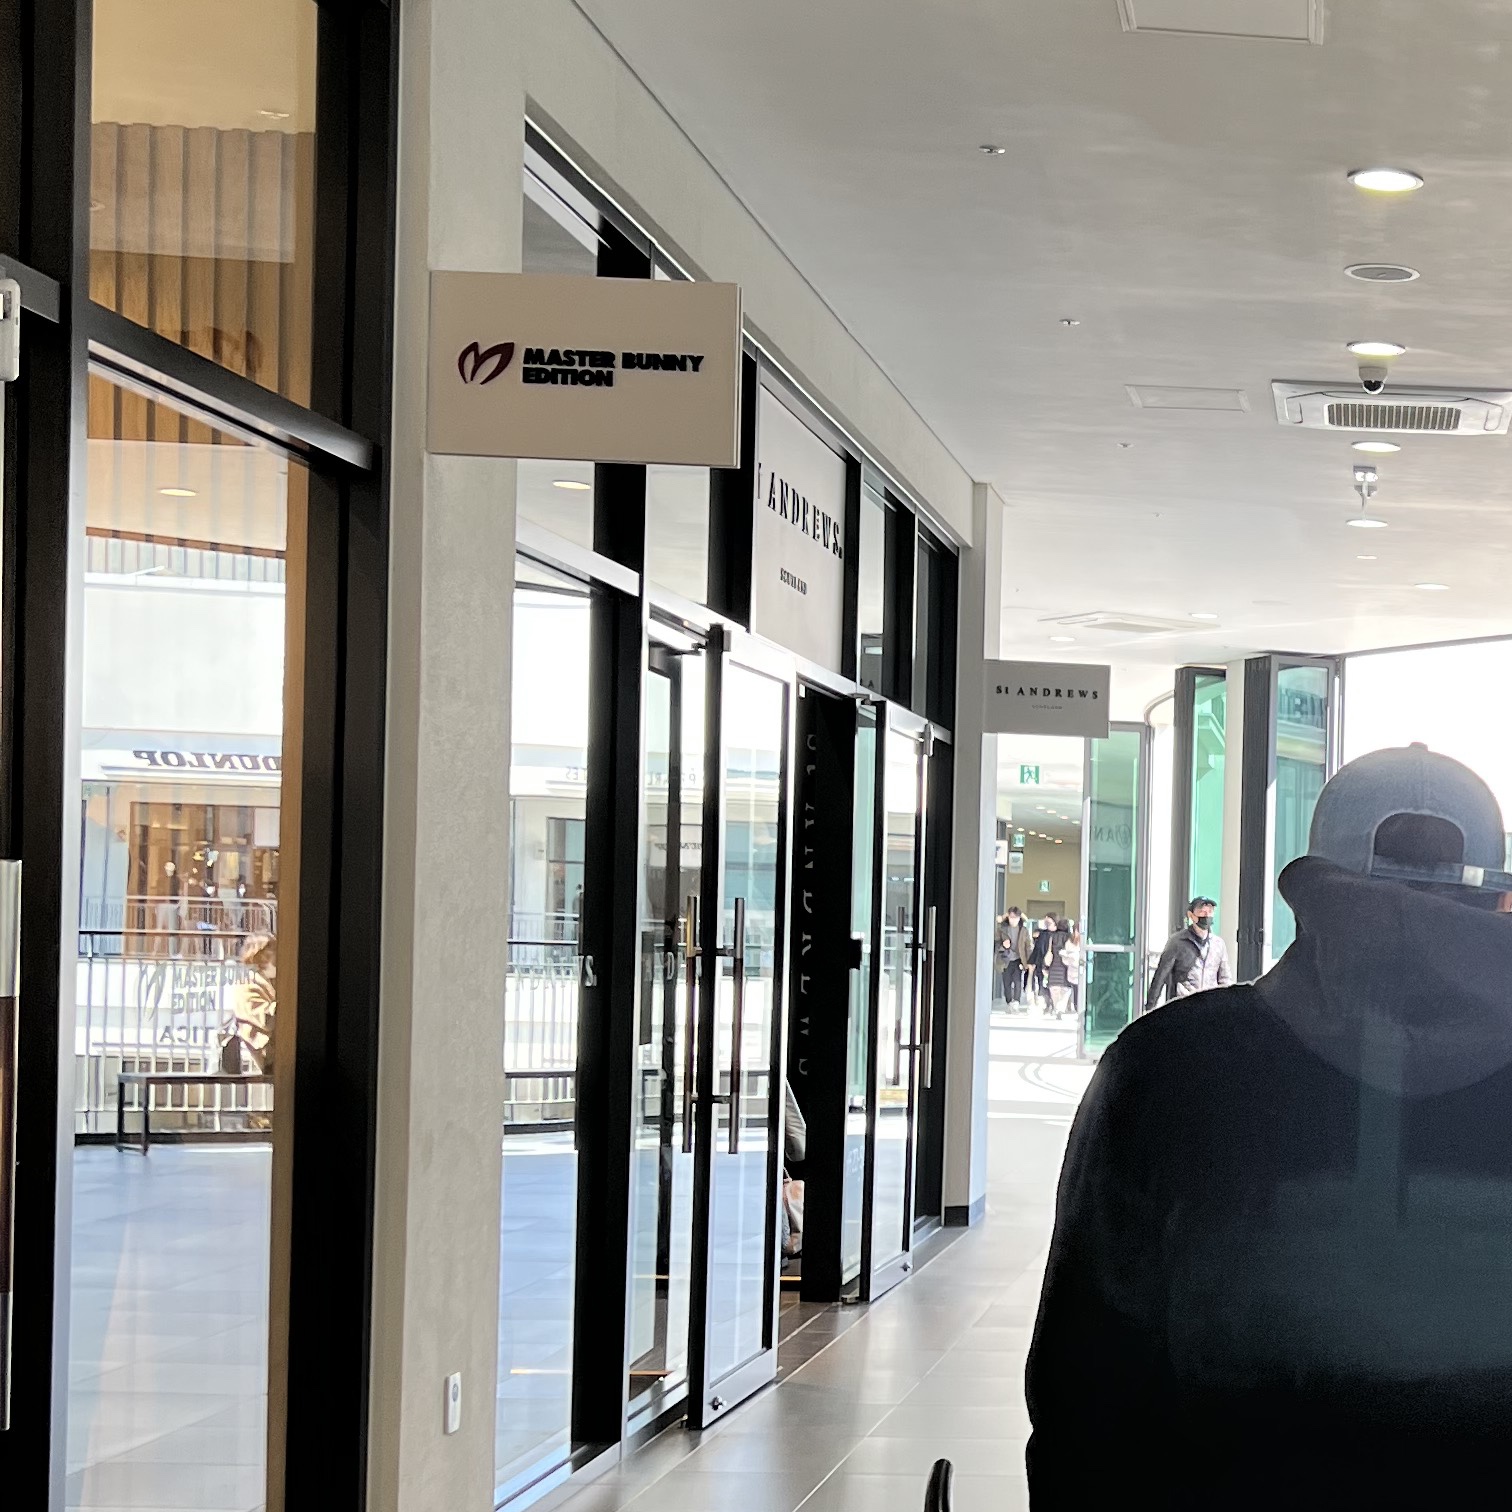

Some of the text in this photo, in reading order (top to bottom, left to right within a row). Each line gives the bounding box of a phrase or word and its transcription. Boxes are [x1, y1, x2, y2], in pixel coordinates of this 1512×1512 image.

[523, 347, 705, 372] MASTER BUNNY
[522, 366, 614, 387] EDITION
[1016, 686, 1099, 700] ANDREWS
